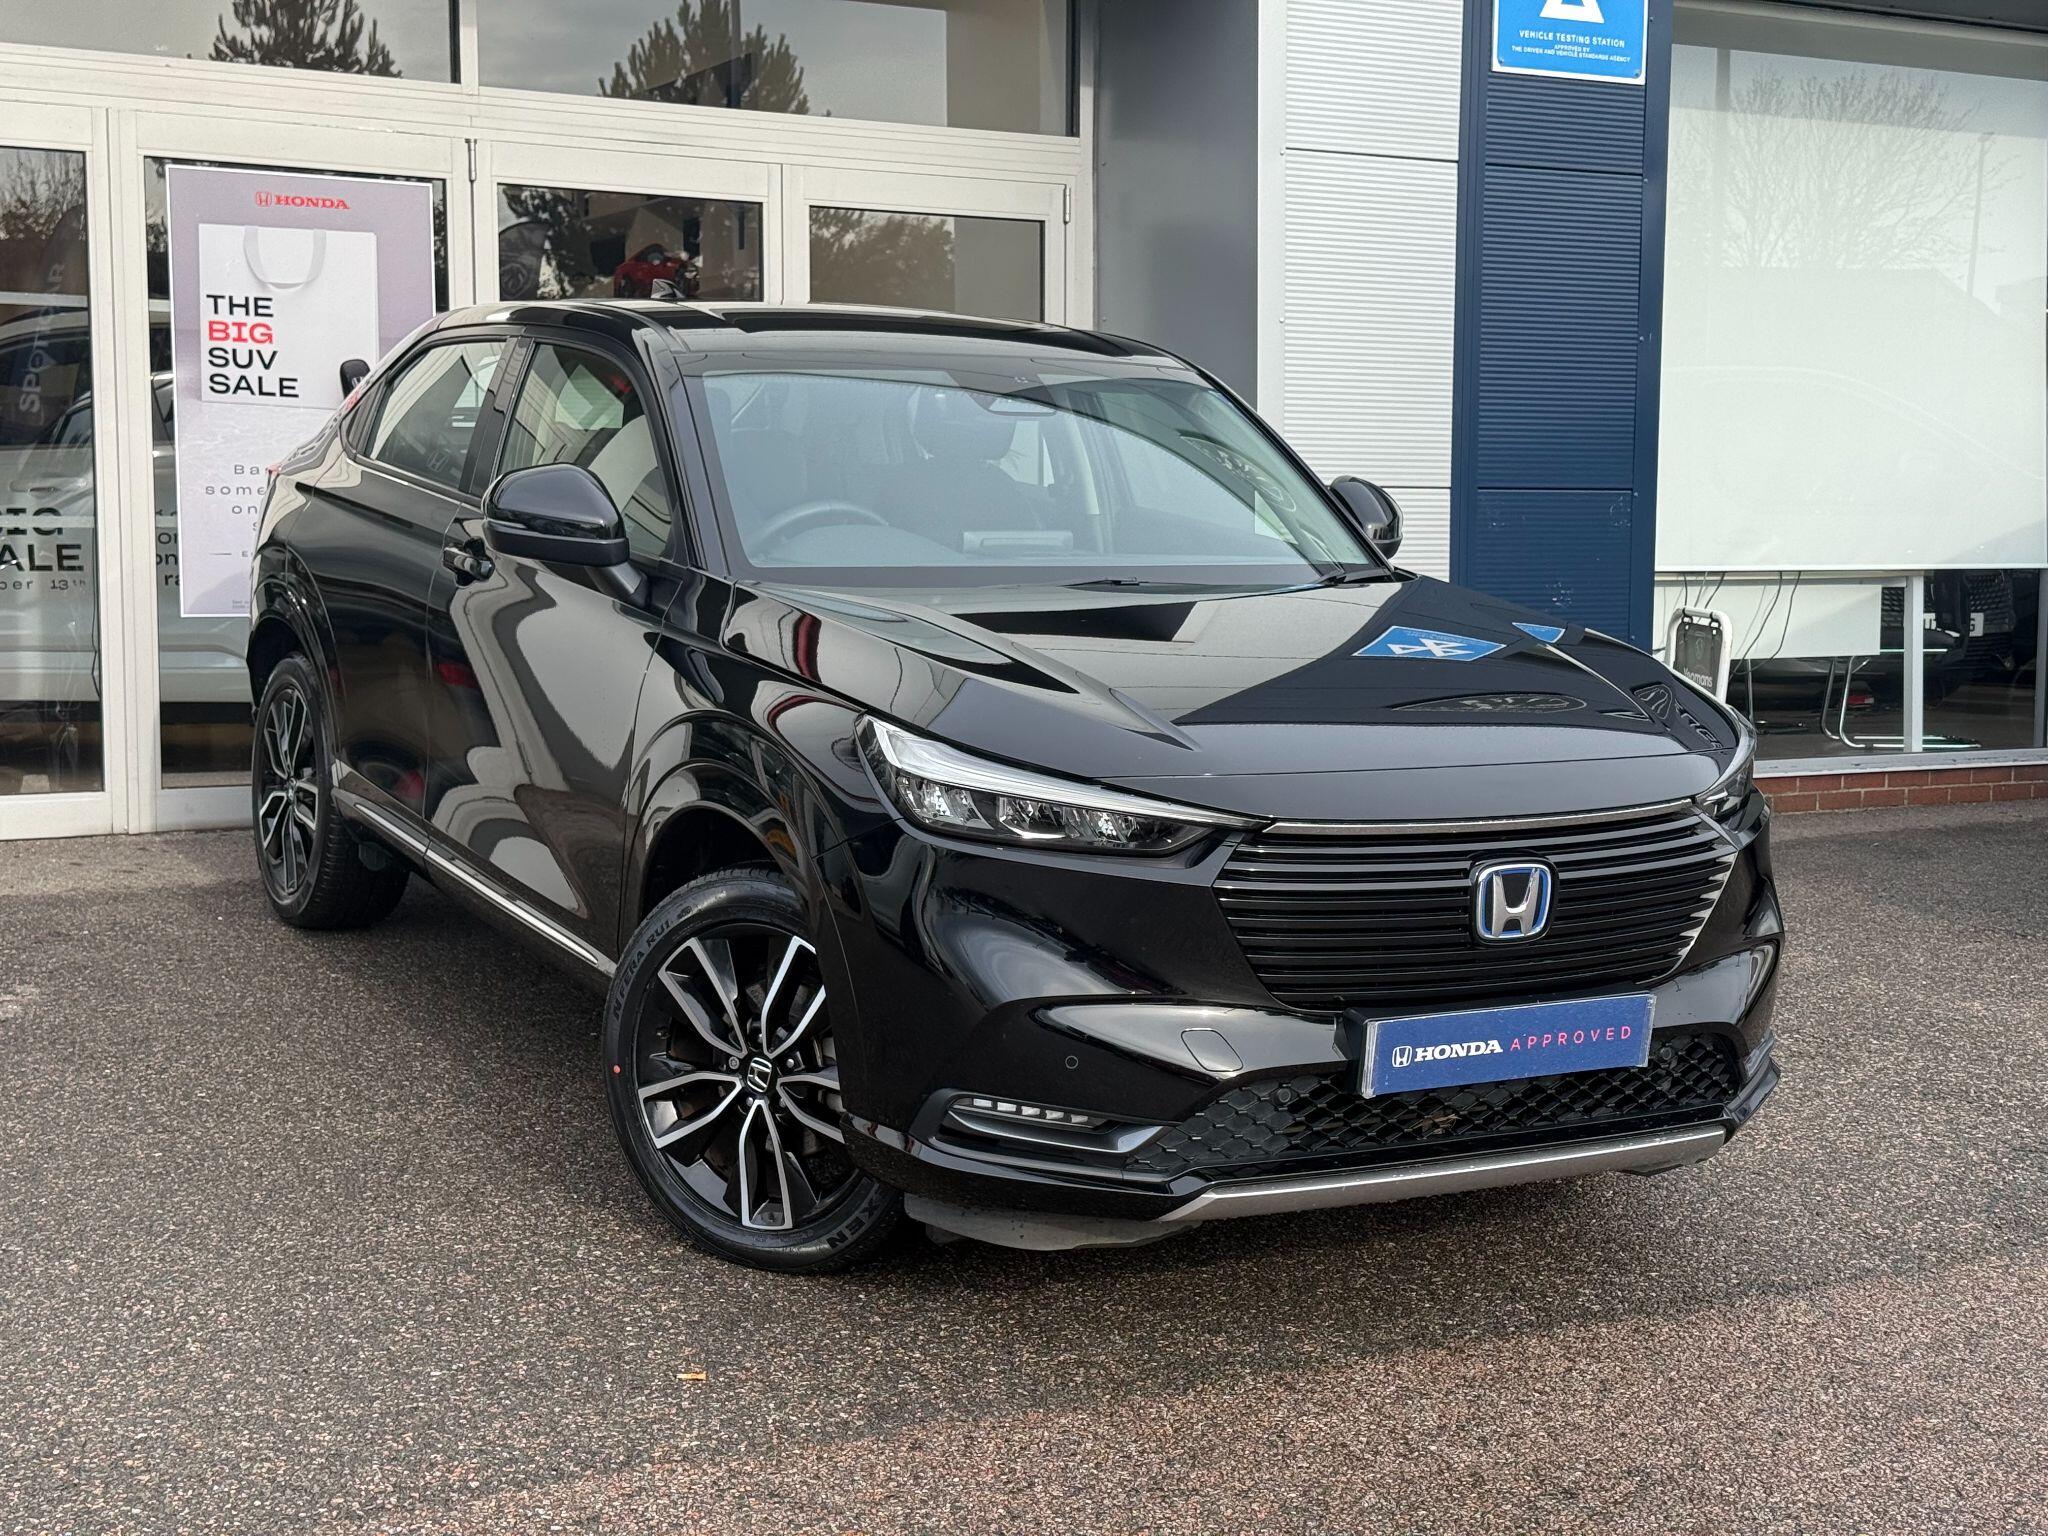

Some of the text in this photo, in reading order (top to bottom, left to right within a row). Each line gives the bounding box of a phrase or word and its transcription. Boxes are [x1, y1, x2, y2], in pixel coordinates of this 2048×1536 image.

[1519, 29, 1625, 48] VEHICLE TESTING STATION
[1554, 44, 1582, 52] APPROVED
[1512, 45, 1523, 53] THE
[1544, 48, 1555, 56] AND
[1556, 50, 1578, 58] VEHICLE
[1578, 51, 1609, 61] STANDARDS
[1609, 54, 1631, 63] AGENCY
[274, 195, 350, 210] HONDA
[206, 294, 274, 318] THE
[208, 320, 274, 344] BIG
[208, 347, 278, 370] SUV
[209, 373, 299, 398] SALE
[0, 507, 63, 536] IG
[1414, 1025, 1631, 1063] HONDA APPROVED
